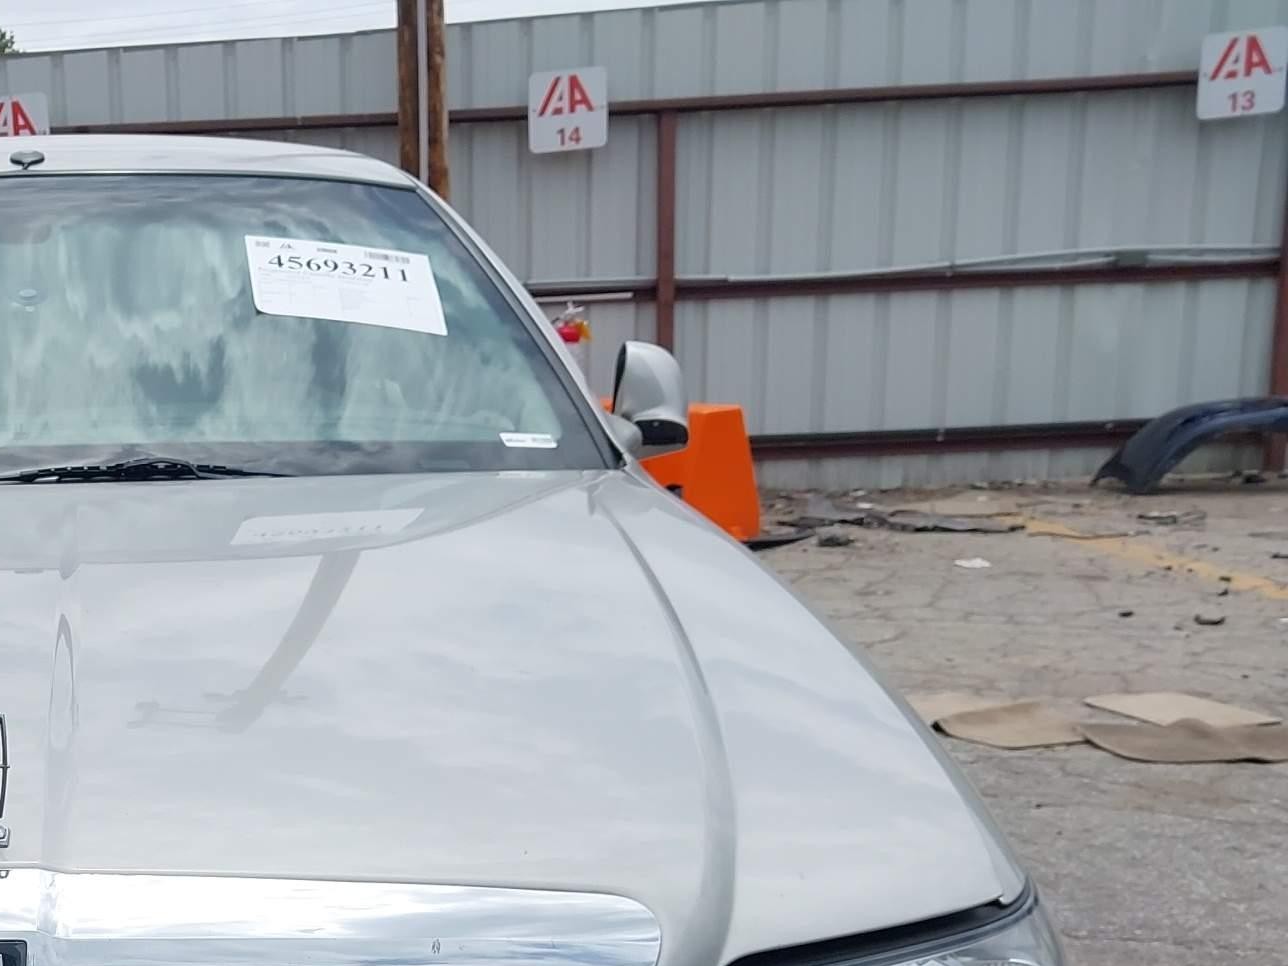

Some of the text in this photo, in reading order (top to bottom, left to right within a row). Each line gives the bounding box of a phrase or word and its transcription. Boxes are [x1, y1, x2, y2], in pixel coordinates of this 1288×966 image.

[1228, 90, 1255, 112] 13
[556, 126, 582, 146] 14
[268, 253, 408, 282] 45693211
